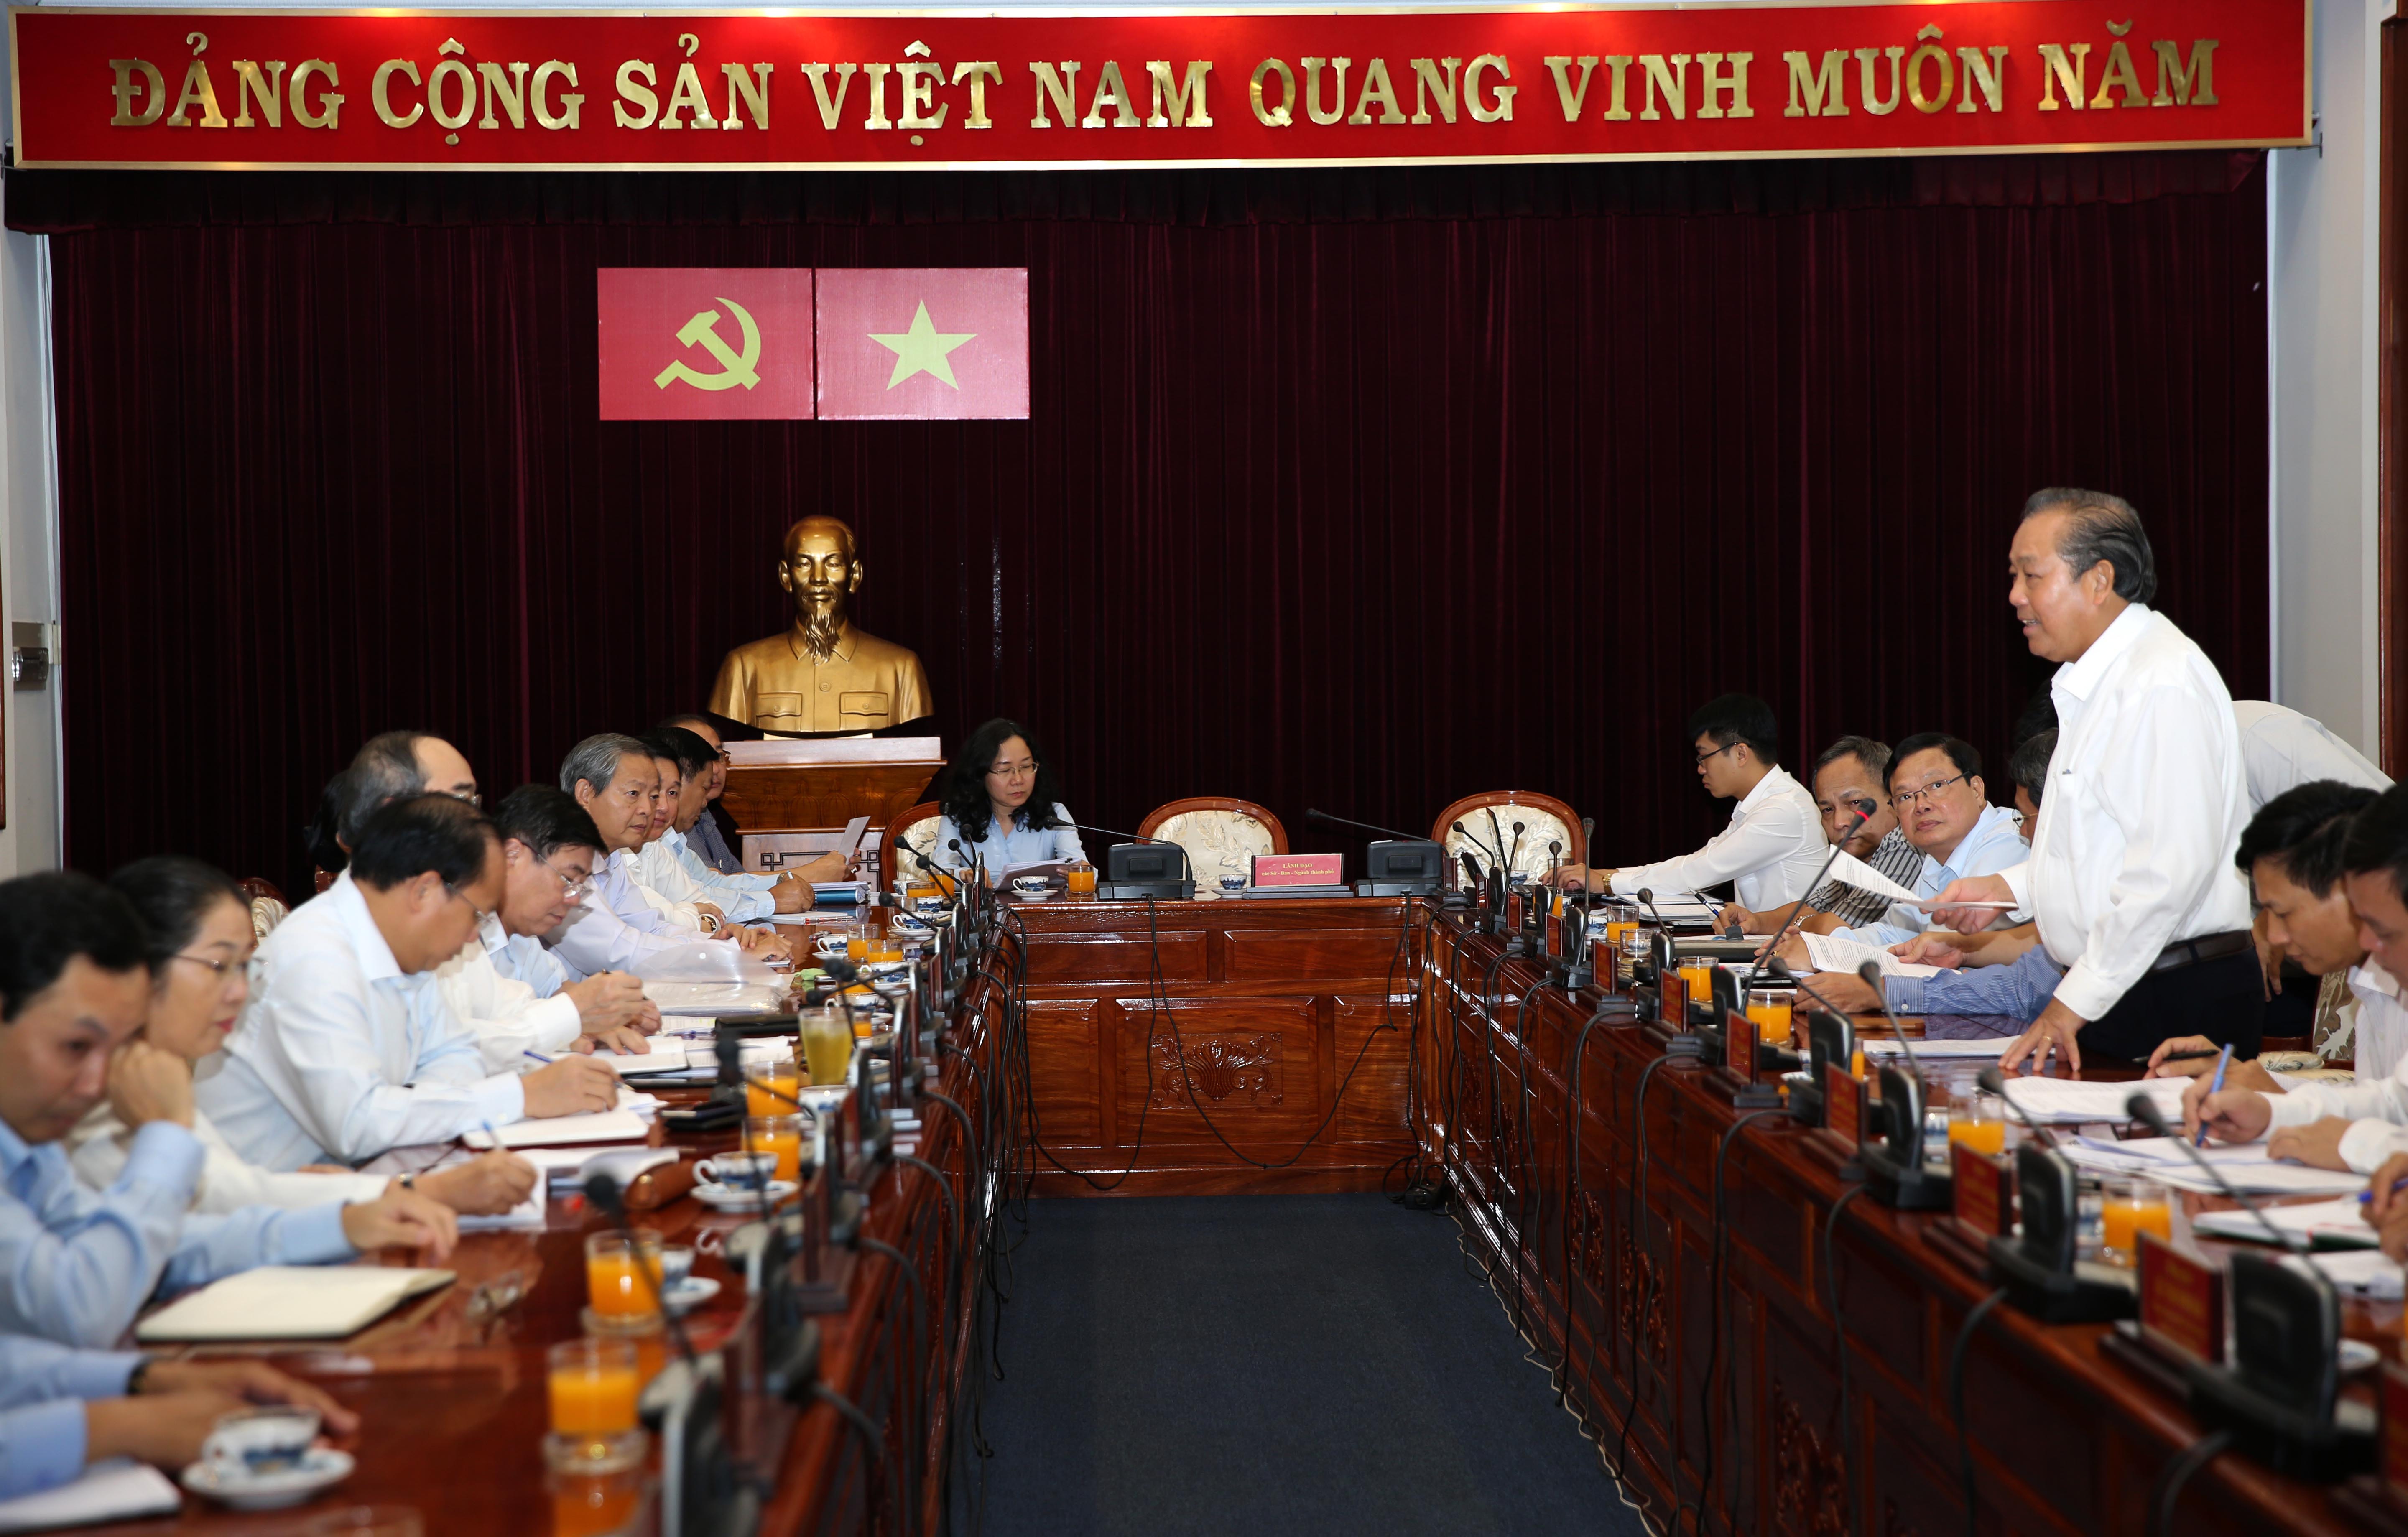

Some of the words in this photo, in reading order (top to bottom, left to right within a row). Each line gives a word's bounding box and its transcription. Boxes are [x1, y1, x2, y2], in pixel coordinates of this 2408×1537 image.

[110, 32, 345, 129] ĐẢNG
[371, 36, 585, 145] CỘNG
[612, 33, 774, 130] SẢN
[801, 39, 1004, 146] VIỆT
[1028, 59, 1214, 128] NAM
[1249, 52, 1518, 128] QUANG
[1543, 51, 1755, 122] VINH
[1782, 23, 2009, 117] MUÔN
[2037, 20, 2218, 111] NĂM
